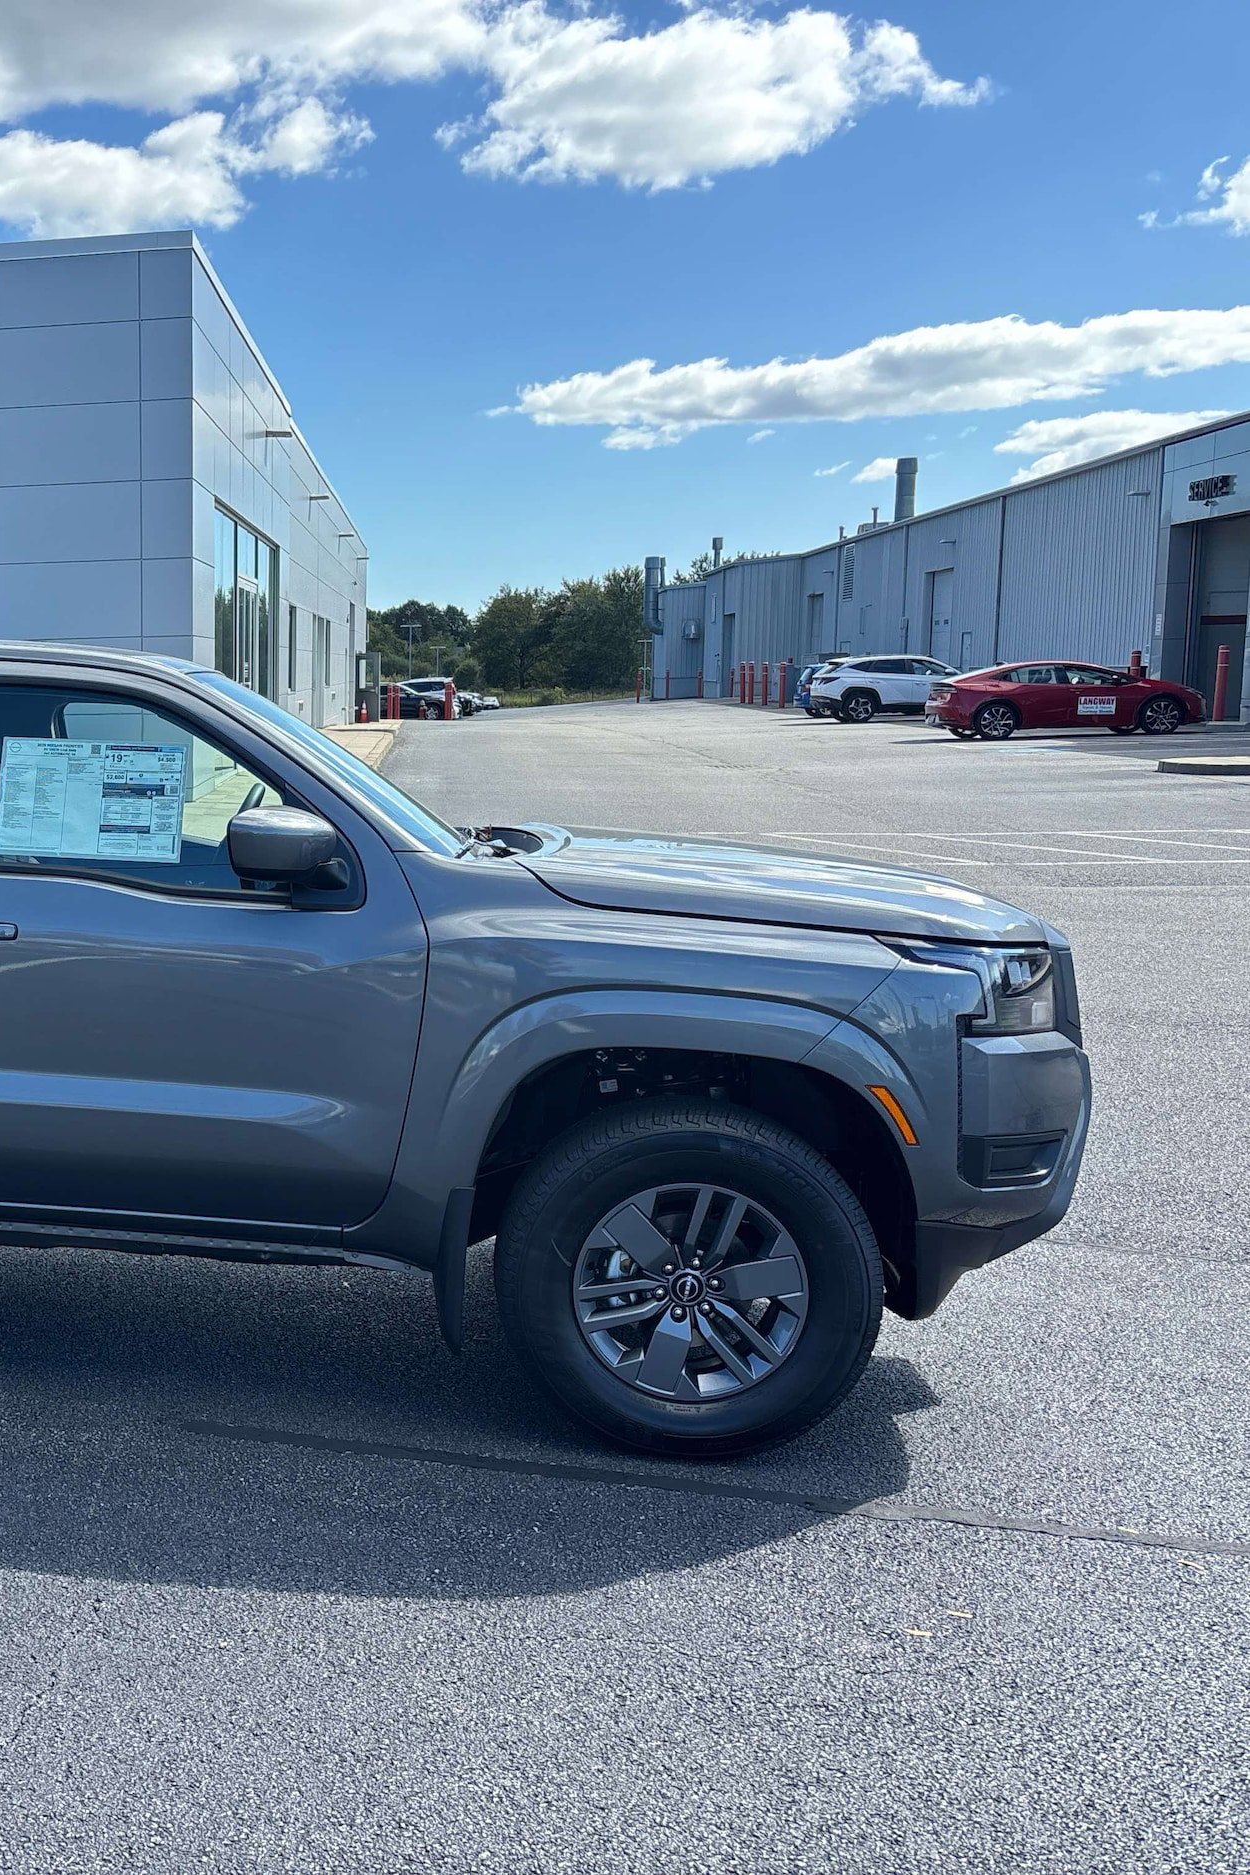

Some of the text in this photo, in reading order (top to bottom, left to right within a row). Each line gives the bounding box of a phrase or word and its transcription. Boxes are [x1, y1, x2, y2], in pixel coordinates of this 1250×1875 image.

[1188, 474, 1237, 502] SERVICE
[1079, 697, 1115, 705] LANGWAY
[111, 753, 123, 763] 19
